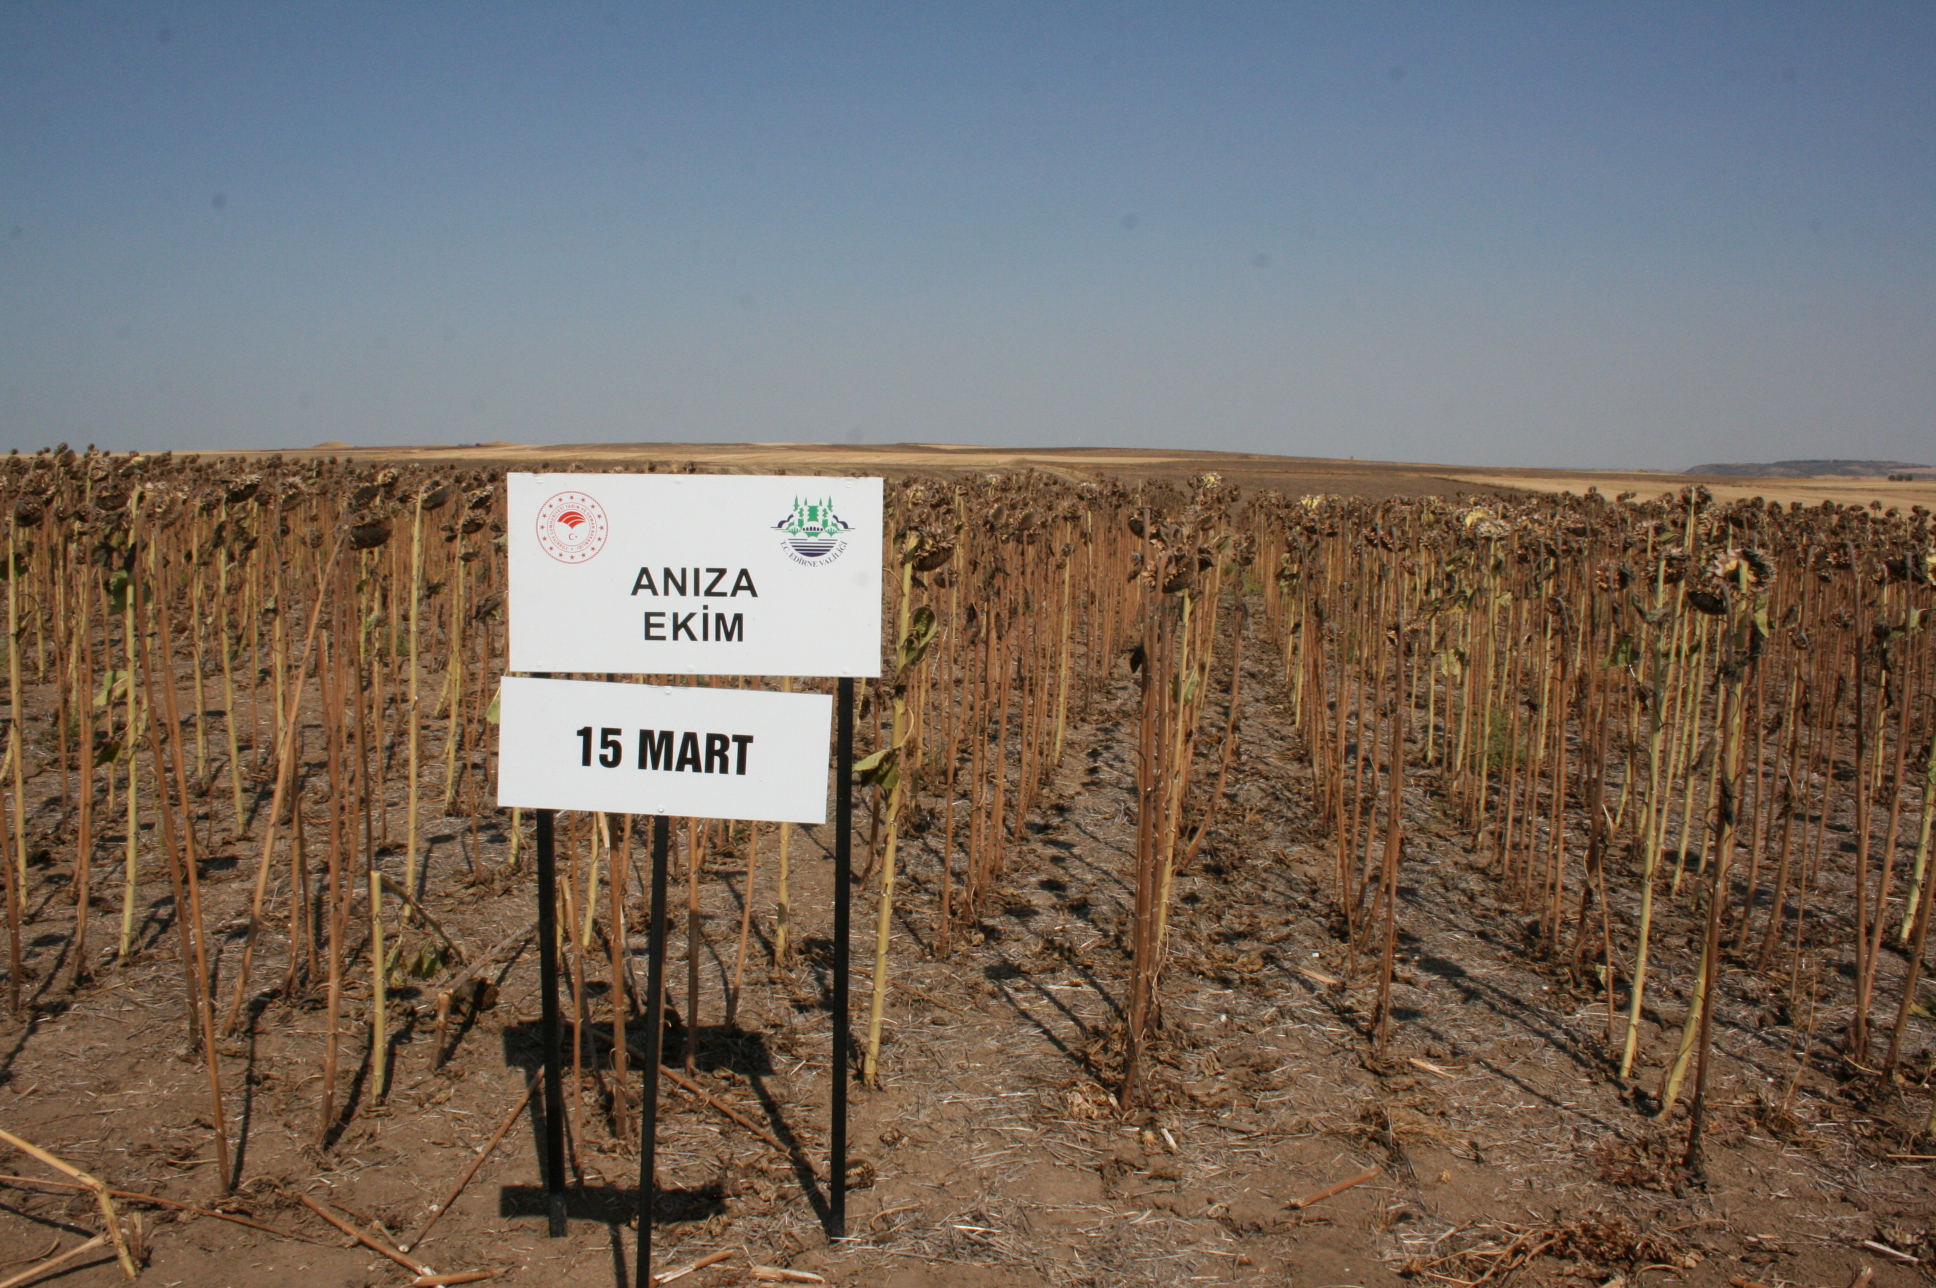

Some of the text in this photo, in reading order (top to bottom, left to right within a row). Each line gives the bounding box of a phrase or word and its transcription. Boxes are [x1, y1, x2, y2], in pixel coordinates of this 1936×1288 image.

[780, 538, 848, 567] T.C. EDİRNE VALİLİĞİ
[630, 566, 759, 598] ANIZA
[644, 605, 744, 642] EKİM
[576, 726, 754, 776] 15 MART
